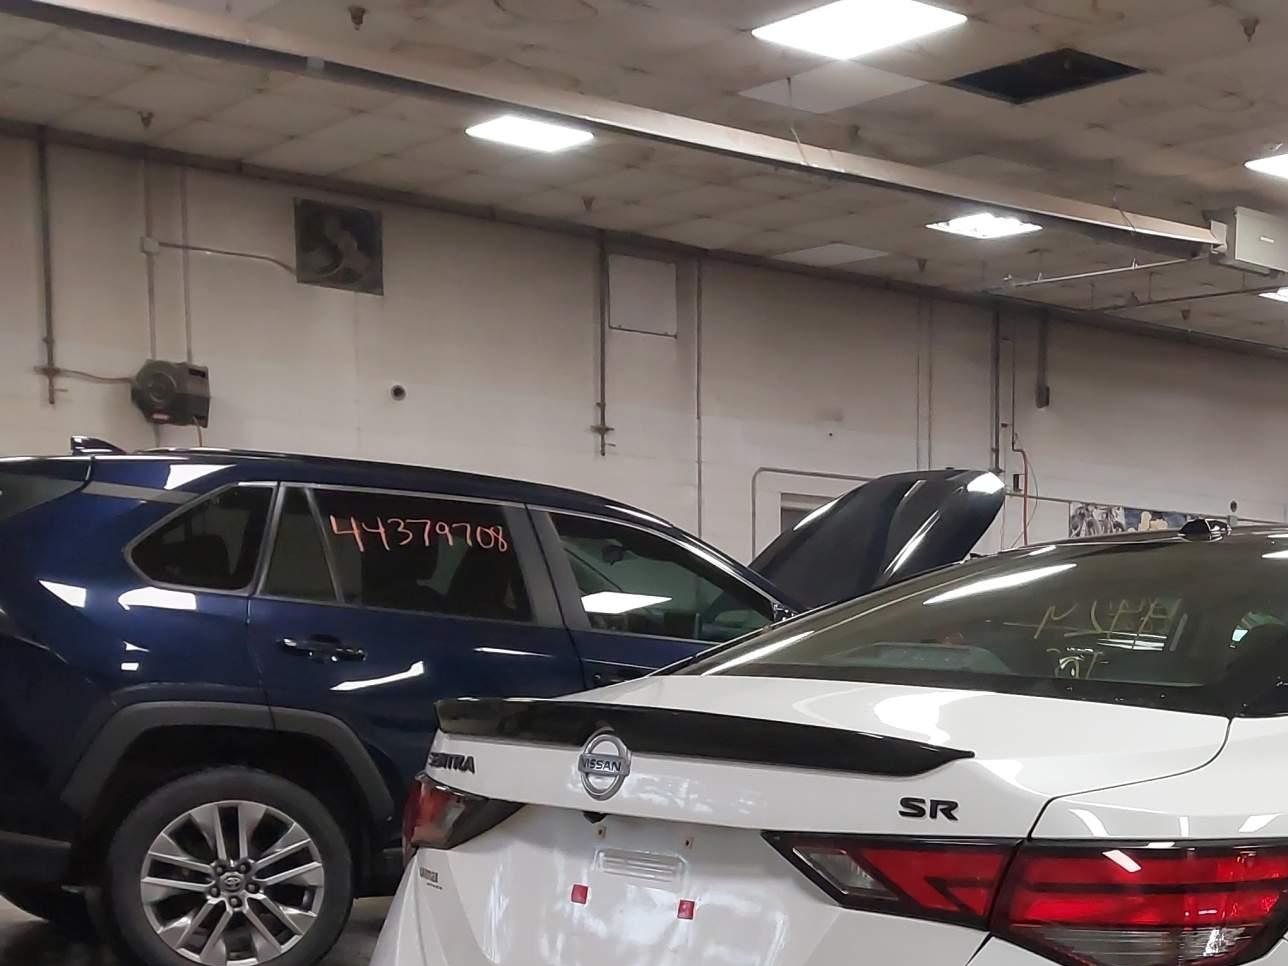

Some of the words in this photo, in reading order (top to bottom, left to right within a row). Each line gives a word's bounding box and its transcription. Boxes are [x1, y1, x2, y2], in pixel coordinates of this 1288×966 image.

[329, 514, 508, 552] 44379708
[583, 758, 621, 772] NISSAN
[899, 797, 959, 821] SR
